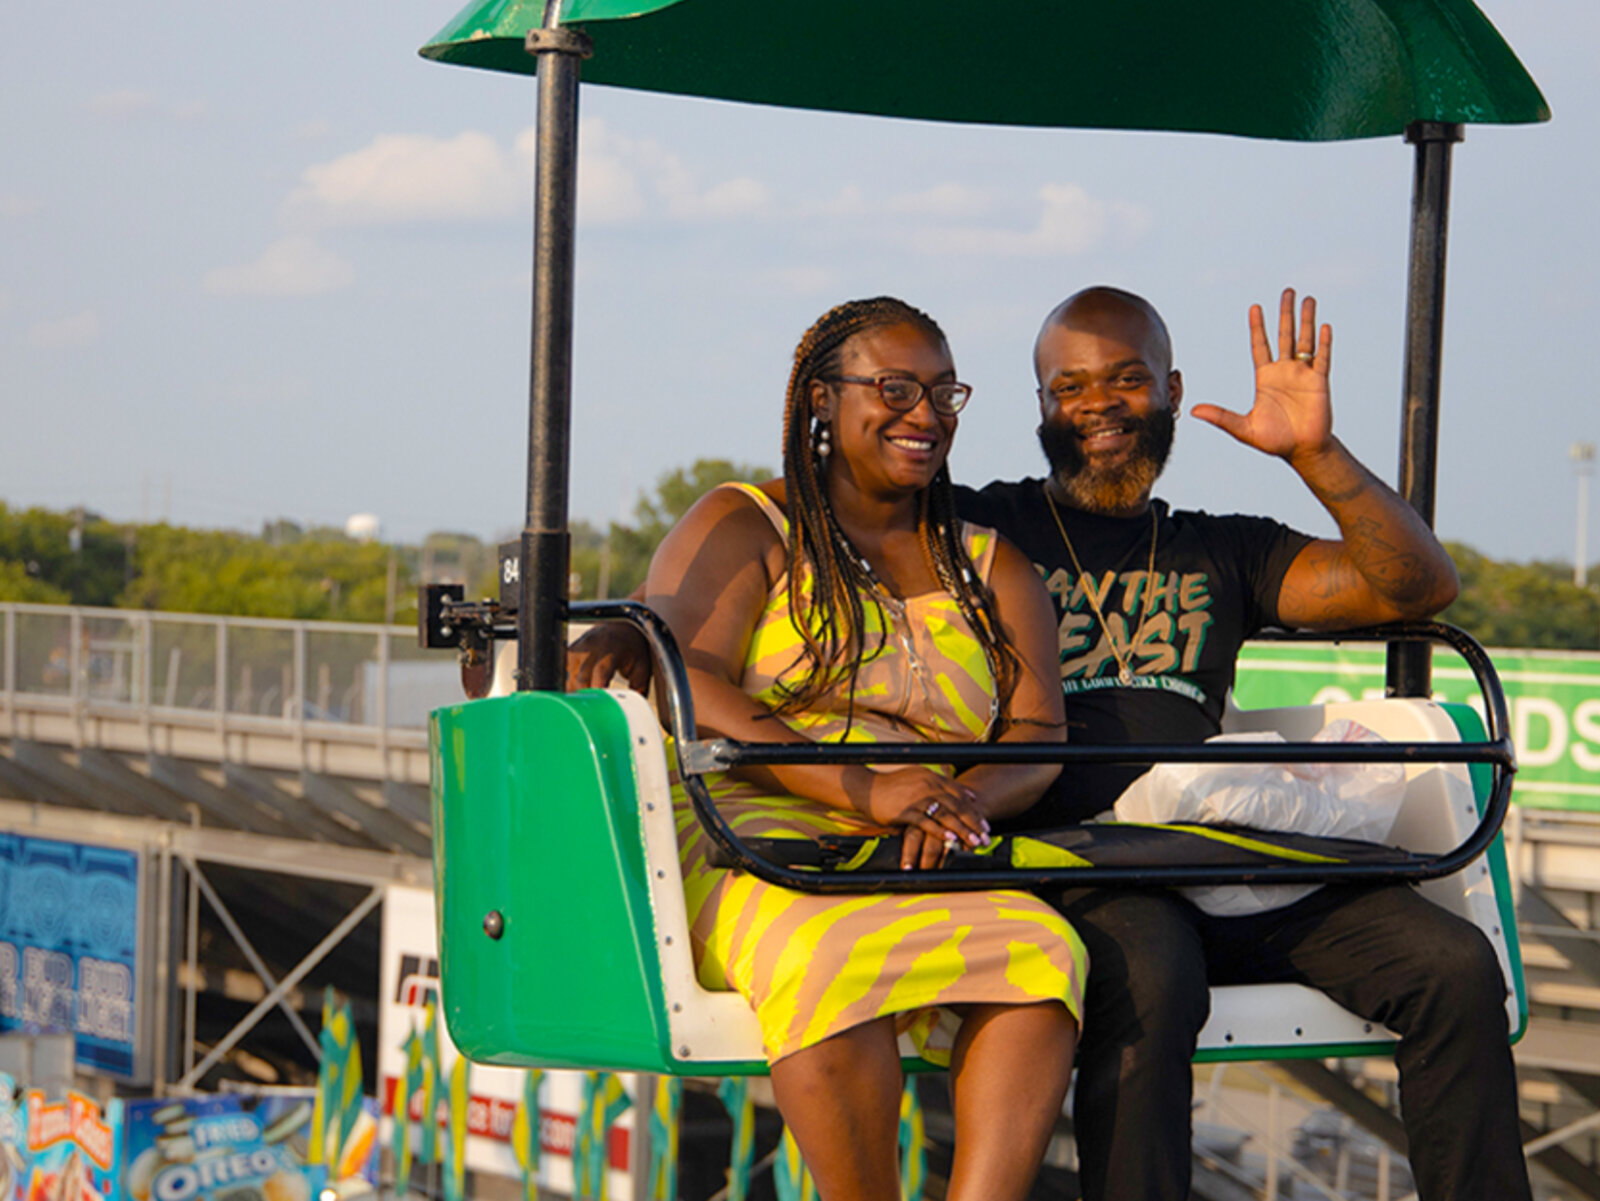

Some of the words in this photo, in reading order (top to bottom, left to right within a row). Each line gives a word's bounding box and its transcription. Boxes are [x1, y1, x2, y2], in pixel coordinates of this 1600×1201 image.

[1033, 562, 1117, 613] AN
[1119, 570, 1213, 615] THE
[157, 1151, 276, 1201] OREO
